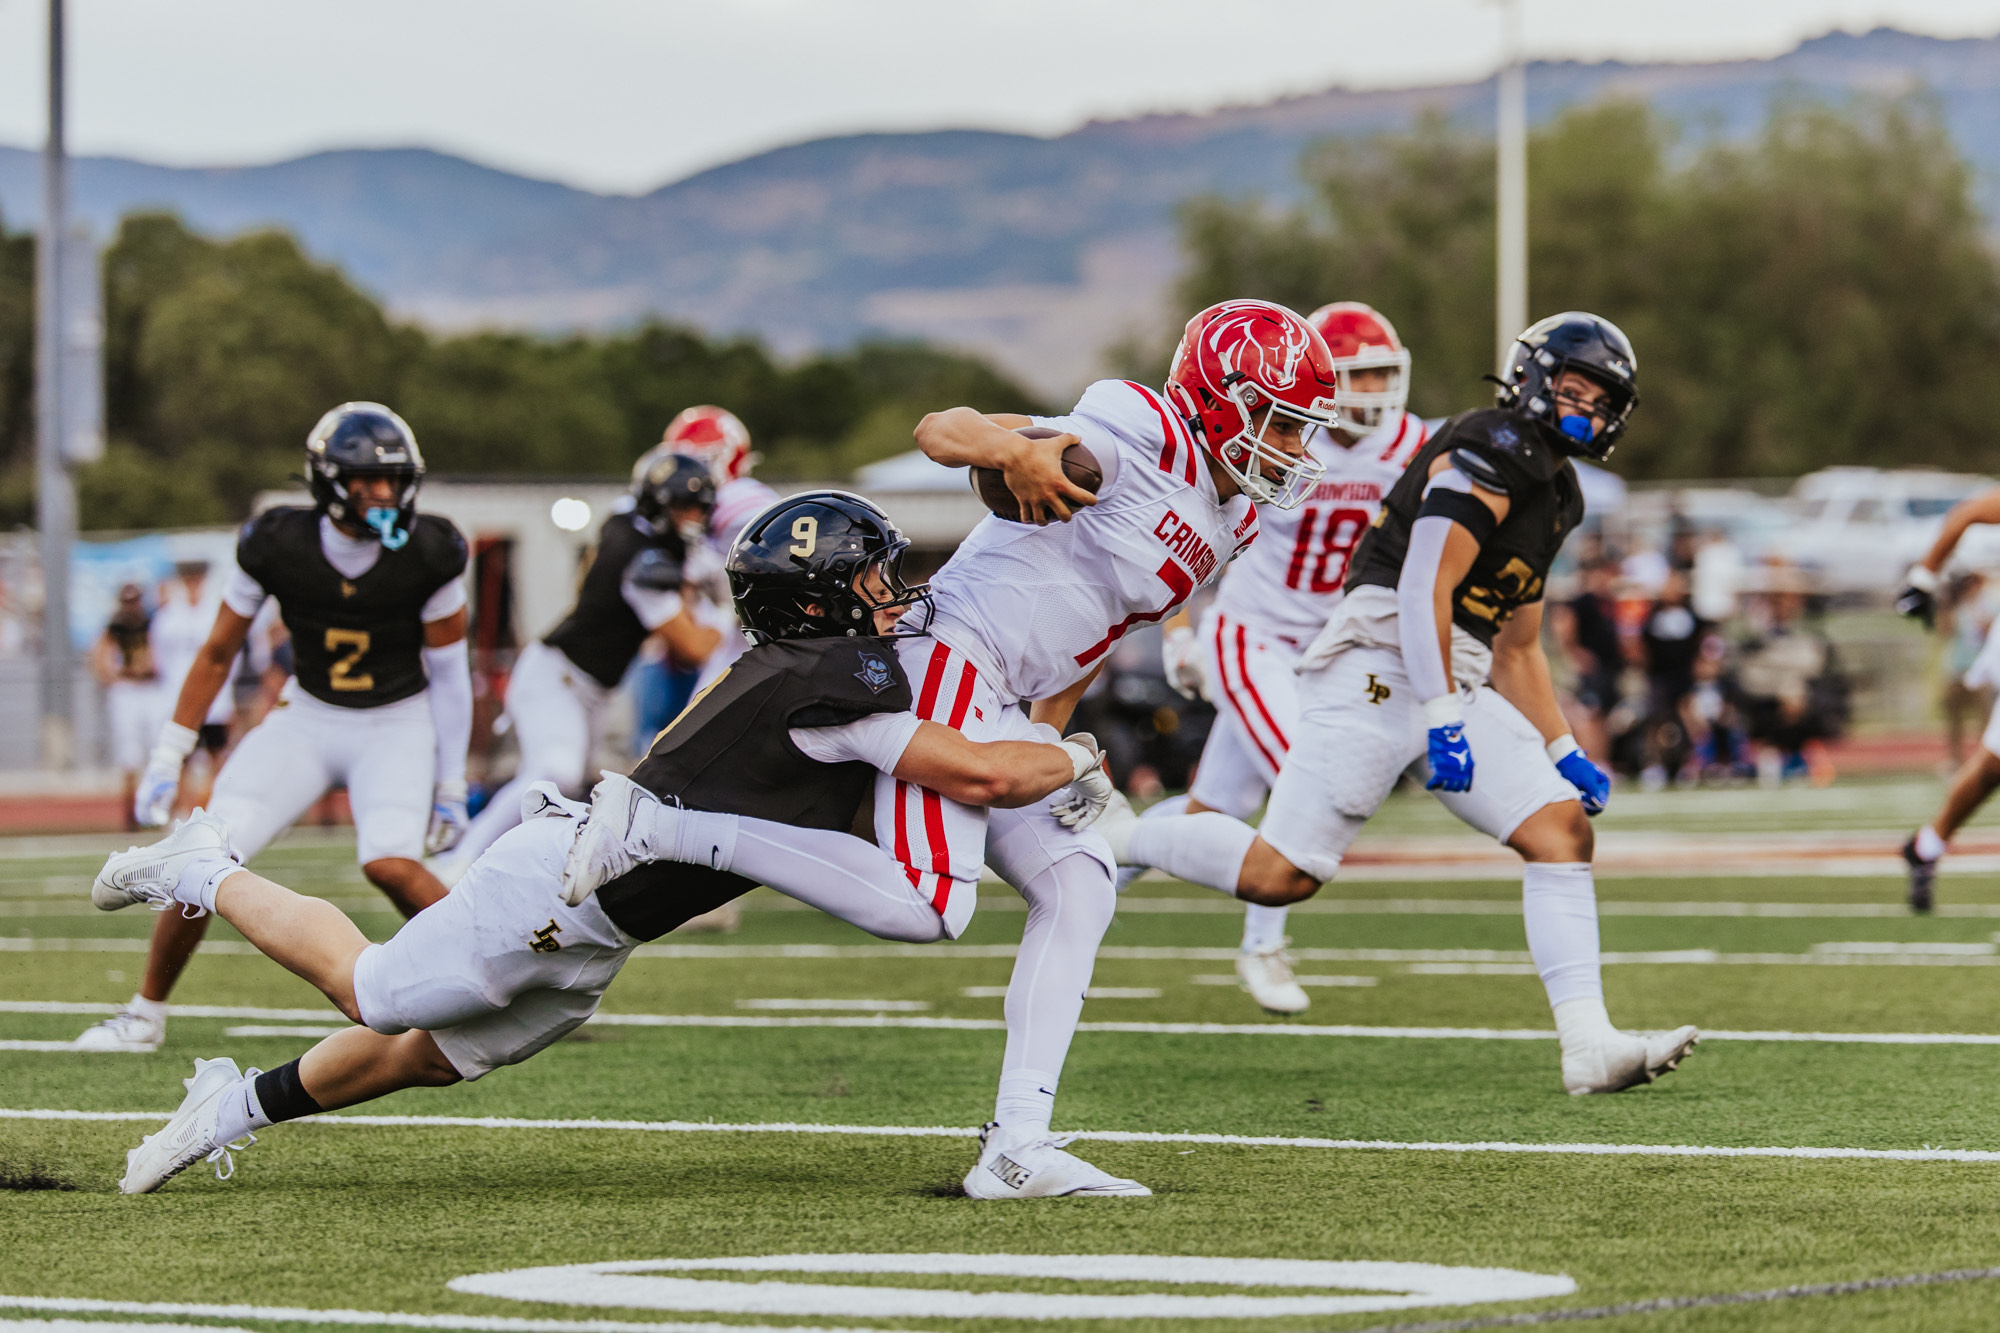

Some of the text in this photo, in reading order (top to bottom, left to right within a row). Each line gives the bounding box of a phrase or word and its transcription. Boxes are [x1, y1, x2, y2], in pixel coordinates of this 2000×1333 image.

[789, 516, 818, 558] 9
[1153, 510, 1219, 586] CRIMSON
[1285, 507, 1369, 594] 18
[1073, 556, 1194, 668] 7
[1461, 557, 1542, 628] 2
[324, 628, 375, 691] 2
